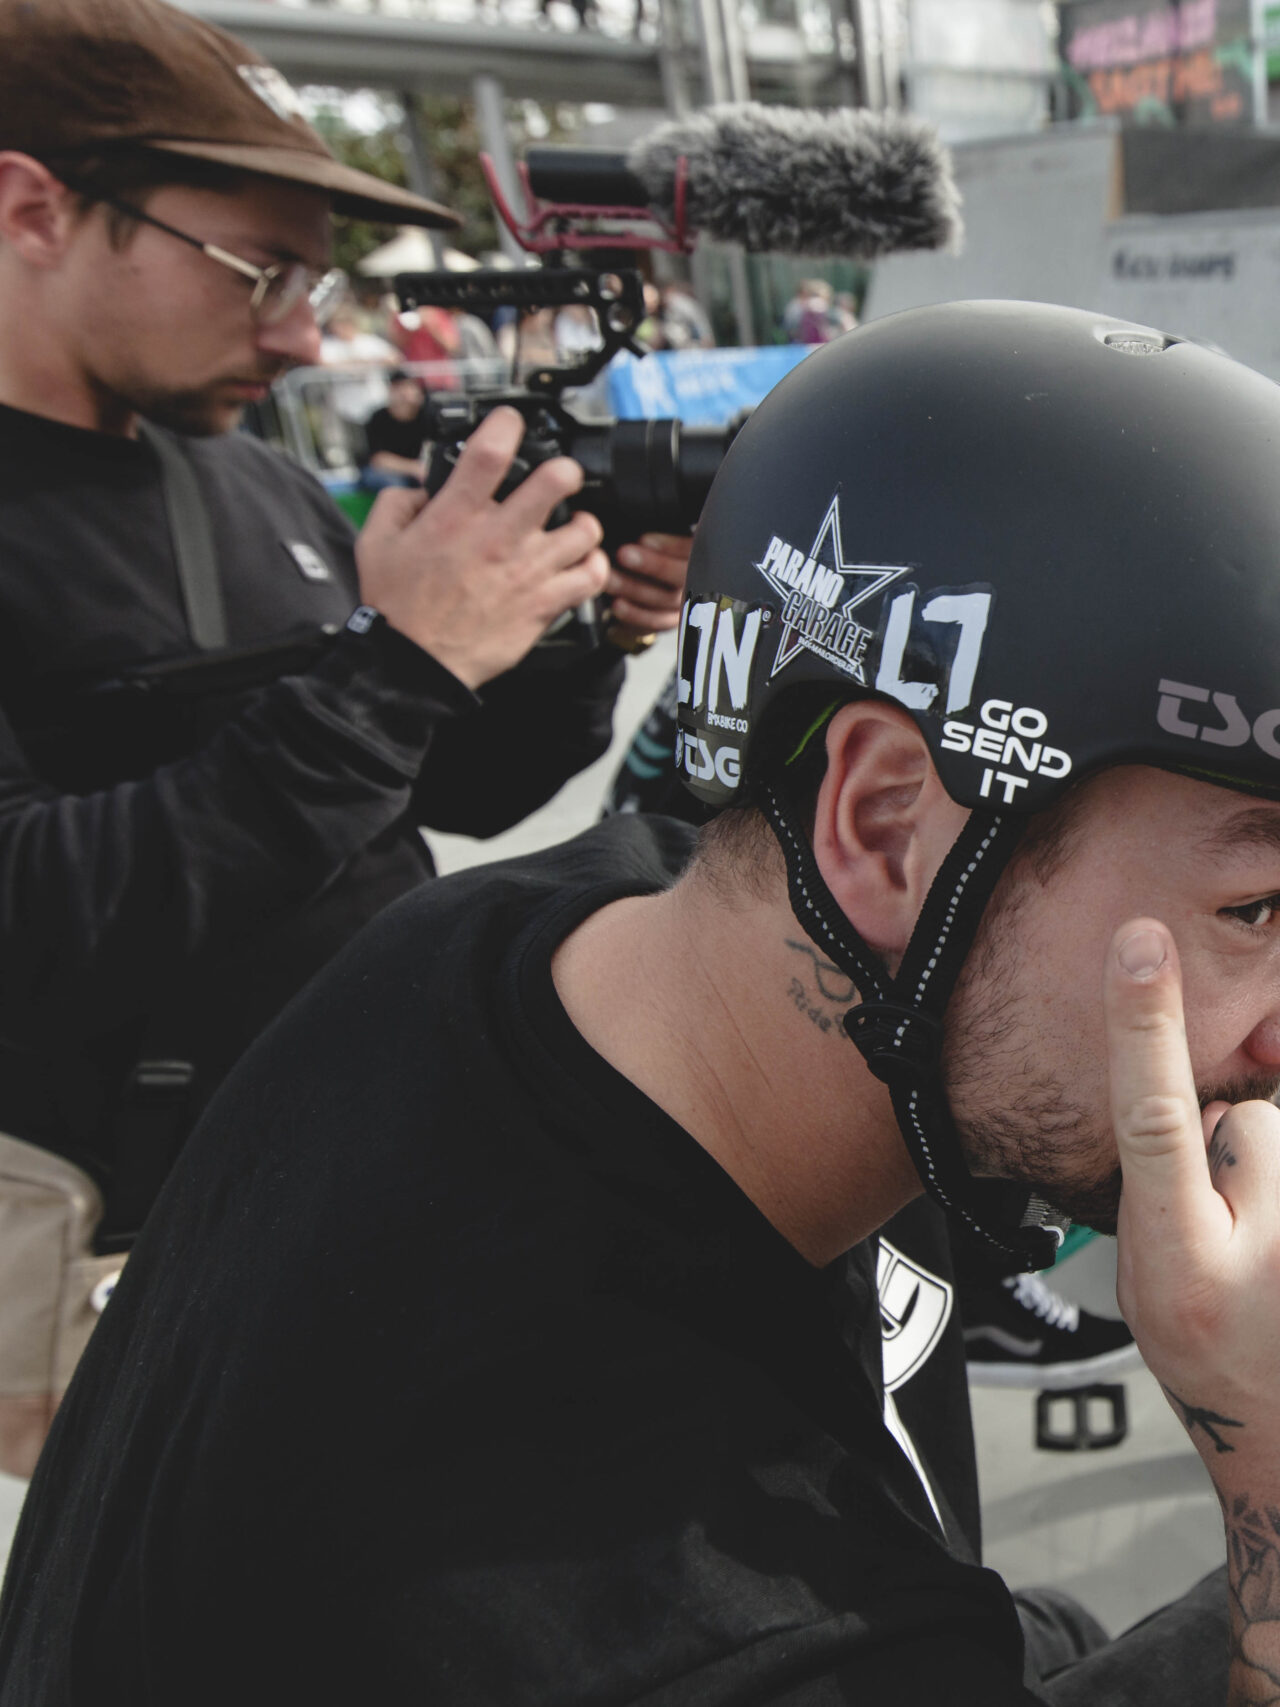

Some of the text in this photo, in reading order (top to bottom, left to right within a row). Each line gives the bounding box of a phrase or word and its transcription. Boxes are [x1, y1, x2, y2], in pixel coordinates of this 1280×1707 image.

[761, 535, 845, 609] PARANO
[781, 589, 873, 666] GARAGE
[980, 699, 1048, 738] GO
[684, 733, 741, 788] TSG
[940, 720, 1073, 779] SEND
[979, 768, 1029, 805] IT
